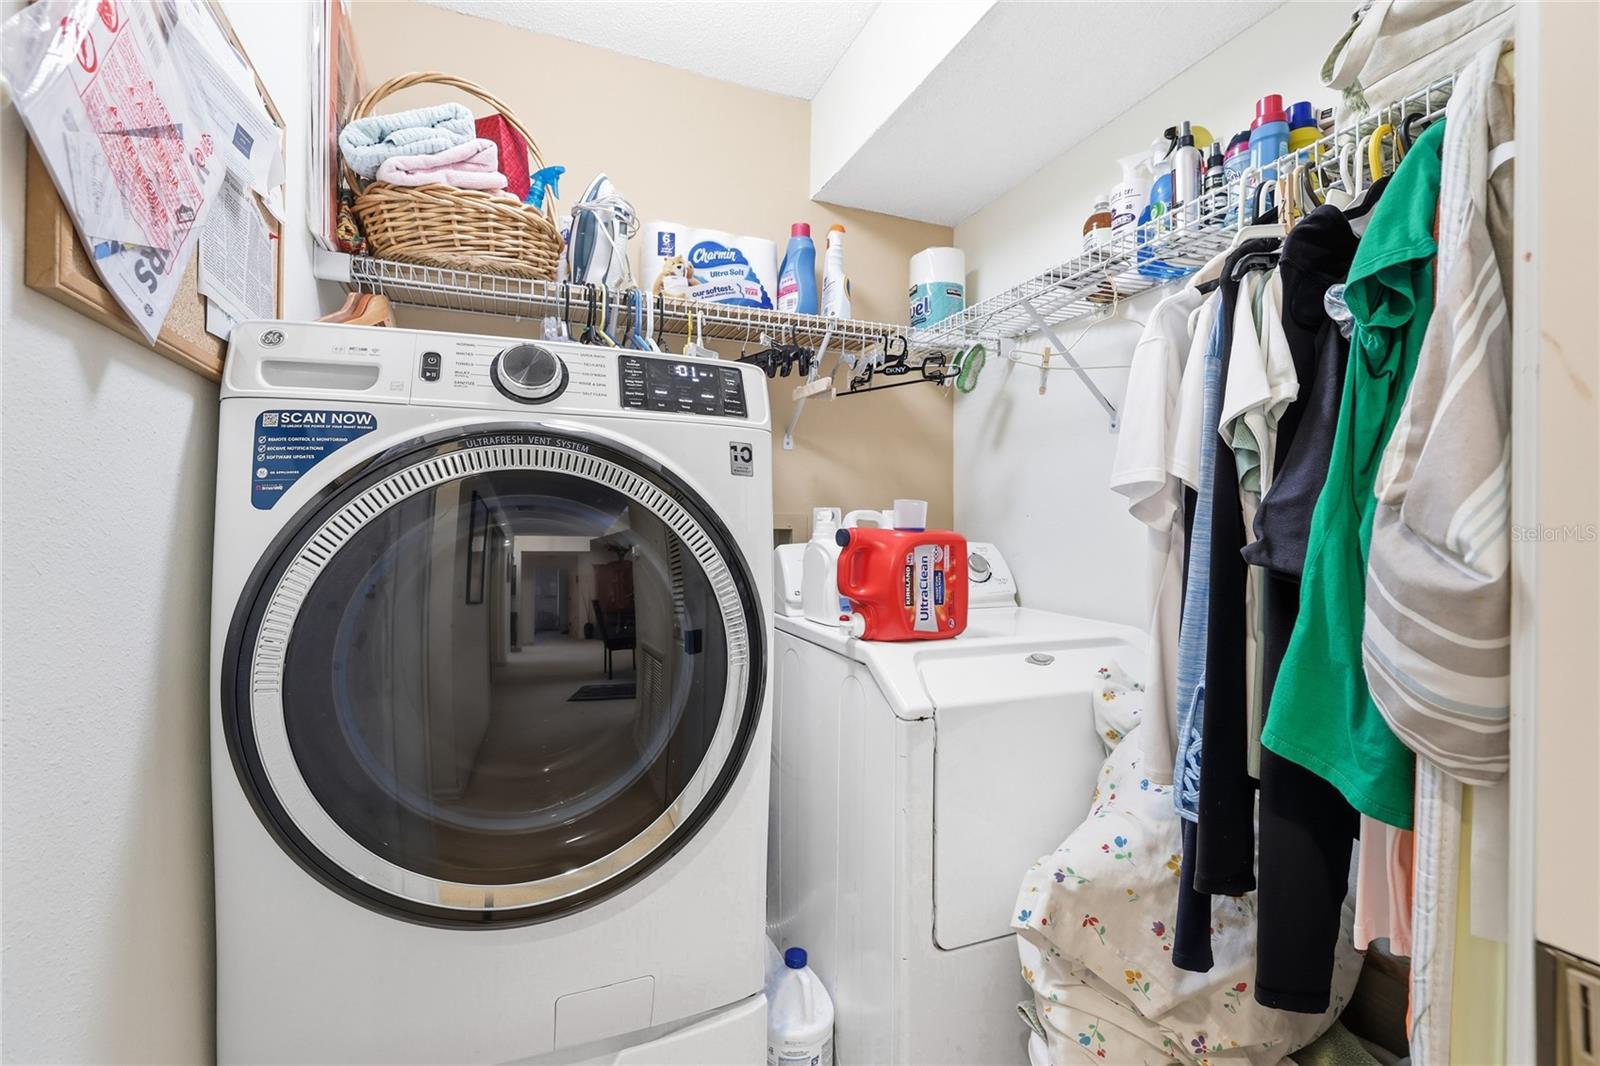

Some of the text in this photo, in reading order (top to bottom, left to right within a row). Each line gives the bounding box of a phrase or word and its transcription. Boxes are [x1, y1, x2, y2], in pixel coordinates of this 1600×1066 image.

[693, 247, 736, 263] Charmin
[710, 269, 744, 278] Ultra Soft
[885, 366, 905, 374] DKNY
[281, 412, 372, 425] SCAN NOW
[466, 435, 589, 453] ULTRAFRESH VENT SYSTEM
[730, 445, 752, 463] 10
[920, 555, 929, 621] UltraClean
